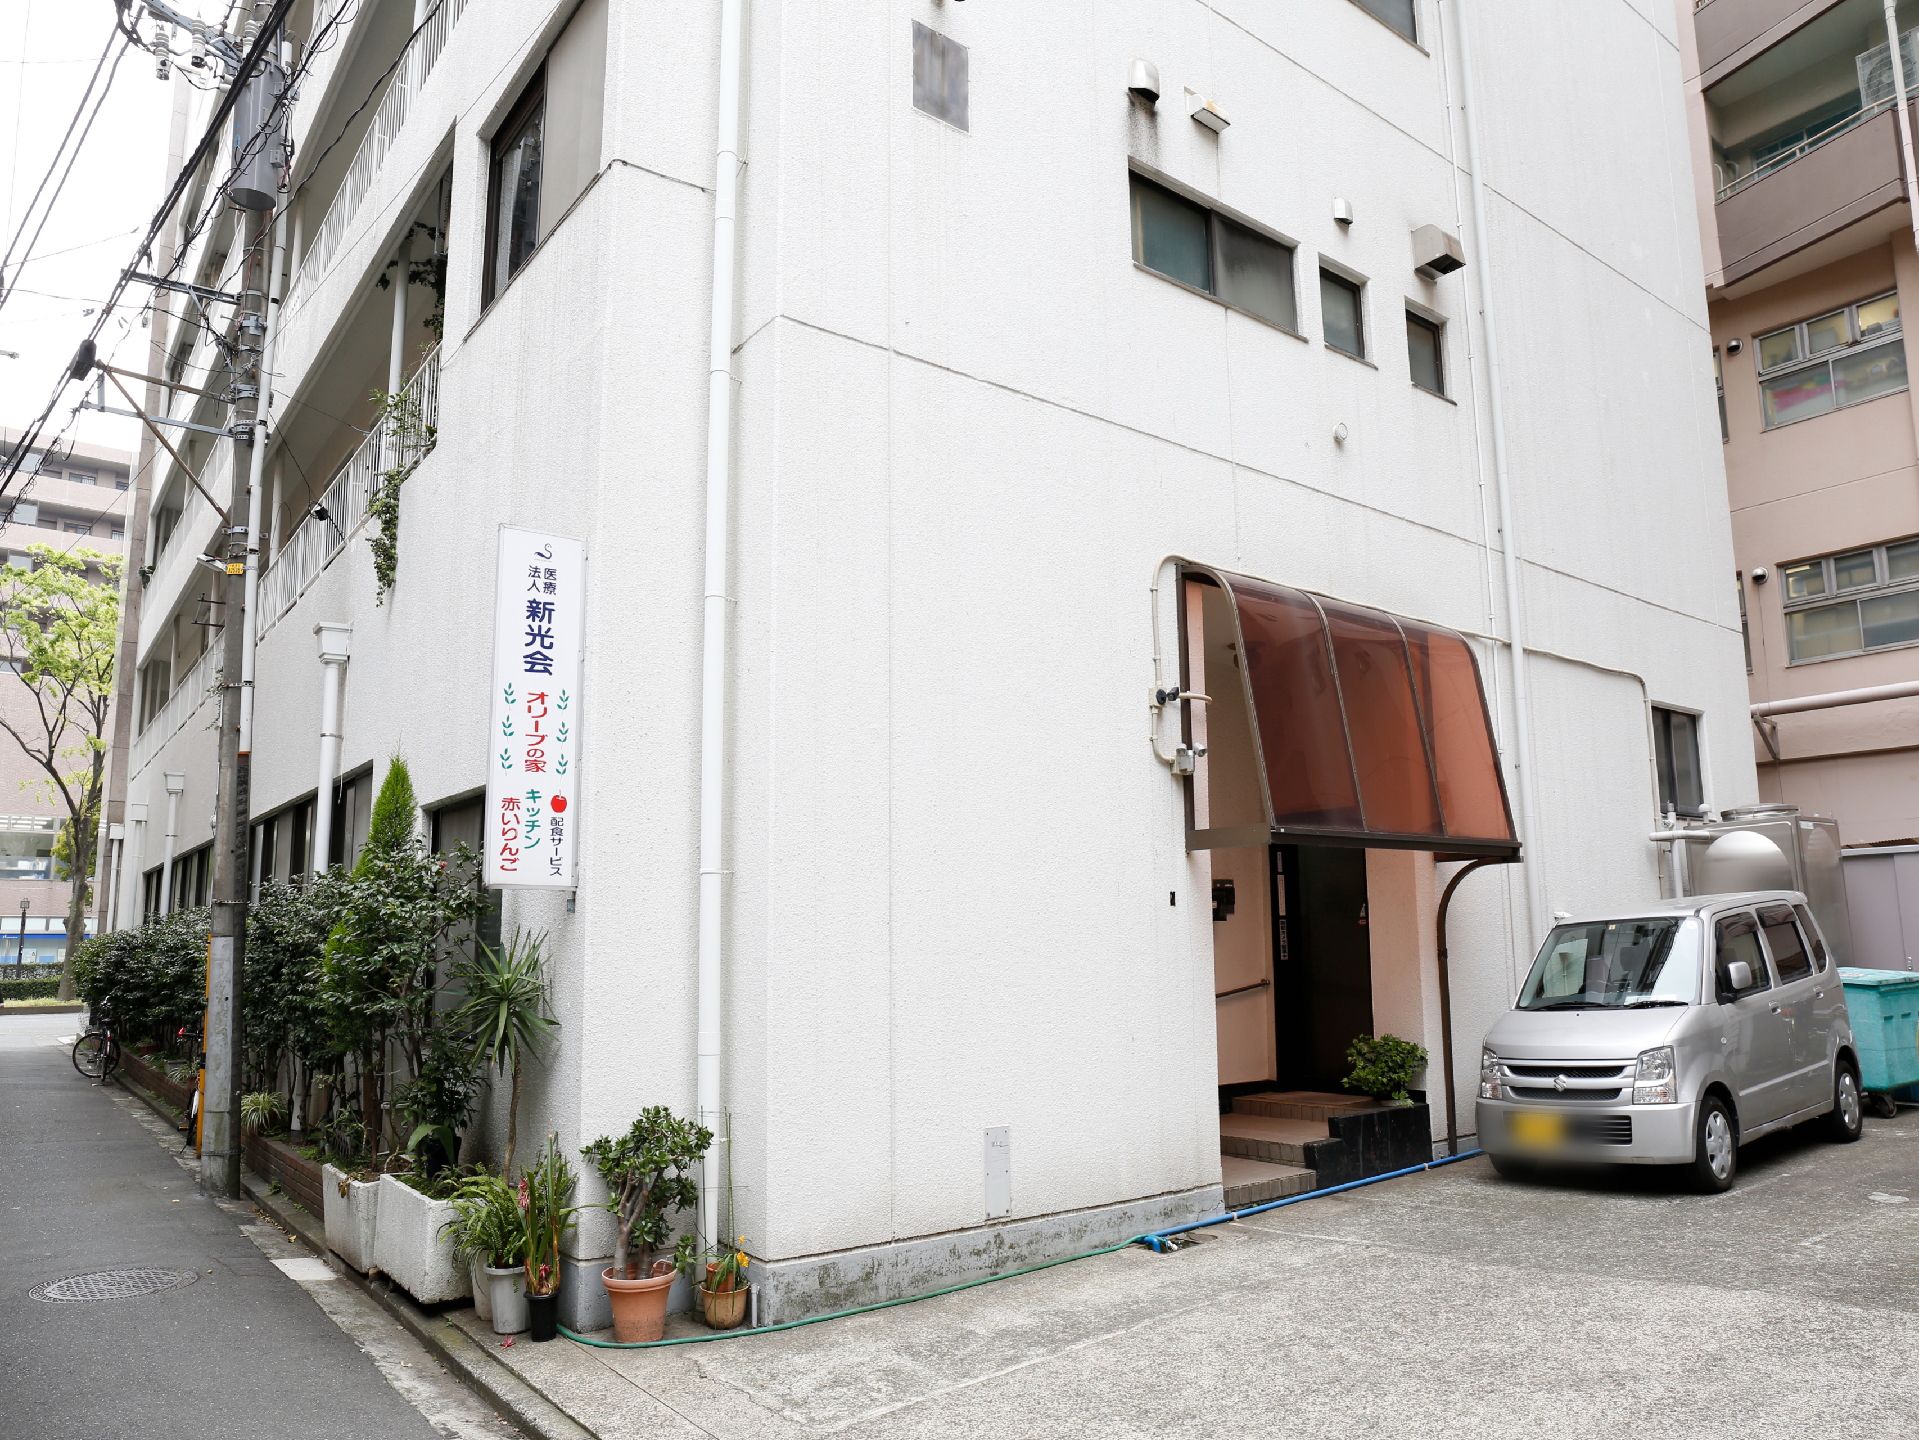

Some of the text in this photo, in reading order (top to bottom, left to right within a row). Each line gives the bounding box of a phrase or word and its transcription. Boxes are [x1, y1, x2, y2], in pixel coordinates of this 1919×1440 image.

[527, 565, 541, 593] 法人
[543, 567, 557, 595] 医療
[523, 598, 556, 676] 新光会
[524, 691, 549, 773] オリーブの家
[499, 796, 521, 872] 赤いりんご
[524, 788, 542, 849] キッチン
[549, 816, 564, 877] 配食サービス
